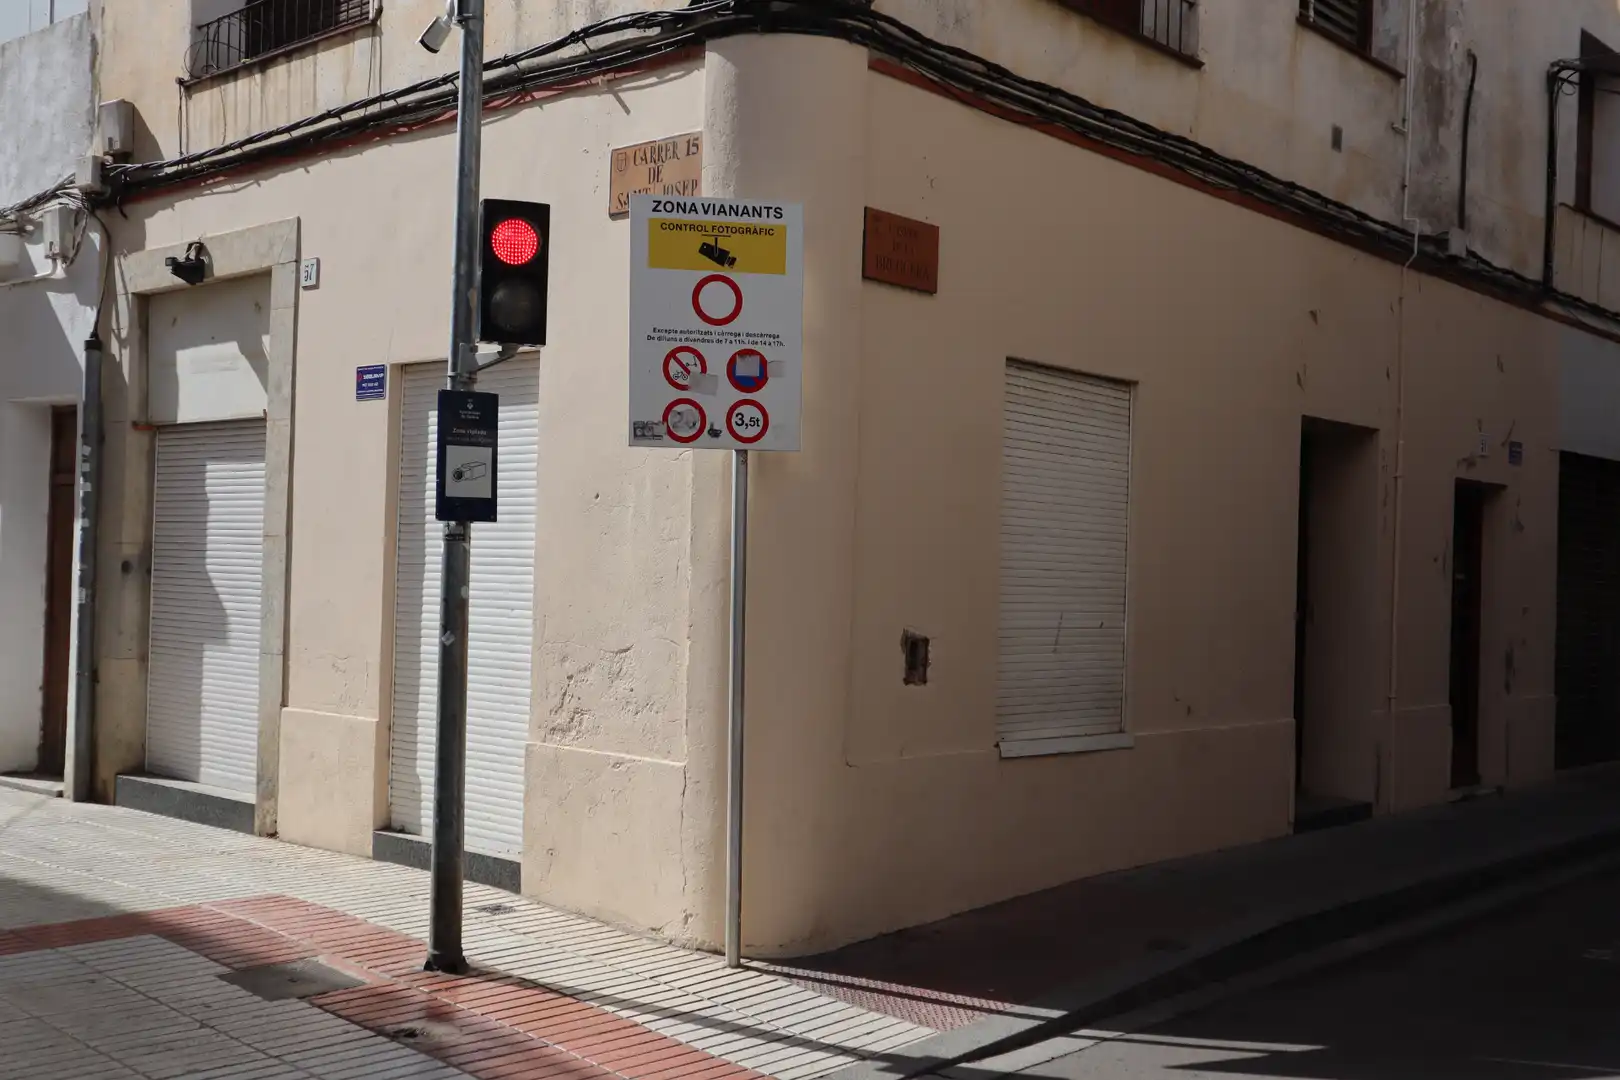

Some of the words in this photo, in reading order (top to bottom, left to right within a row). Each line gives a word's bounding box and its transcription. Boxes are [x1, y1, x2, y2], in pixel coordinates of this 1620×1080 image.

[633, 141, 680, 166] CARRER
[685, 136, 700, 157] 15
[648, 165, 663, 184] DE
[652, 200, 698, 216] ZONA
[701, 203, 783, 219] VIANANTS
[660, 222, 709, 233] CONTROL
[653, 327, 678, 335] Excepte
[735, 412, 760, 429] 3,5t
